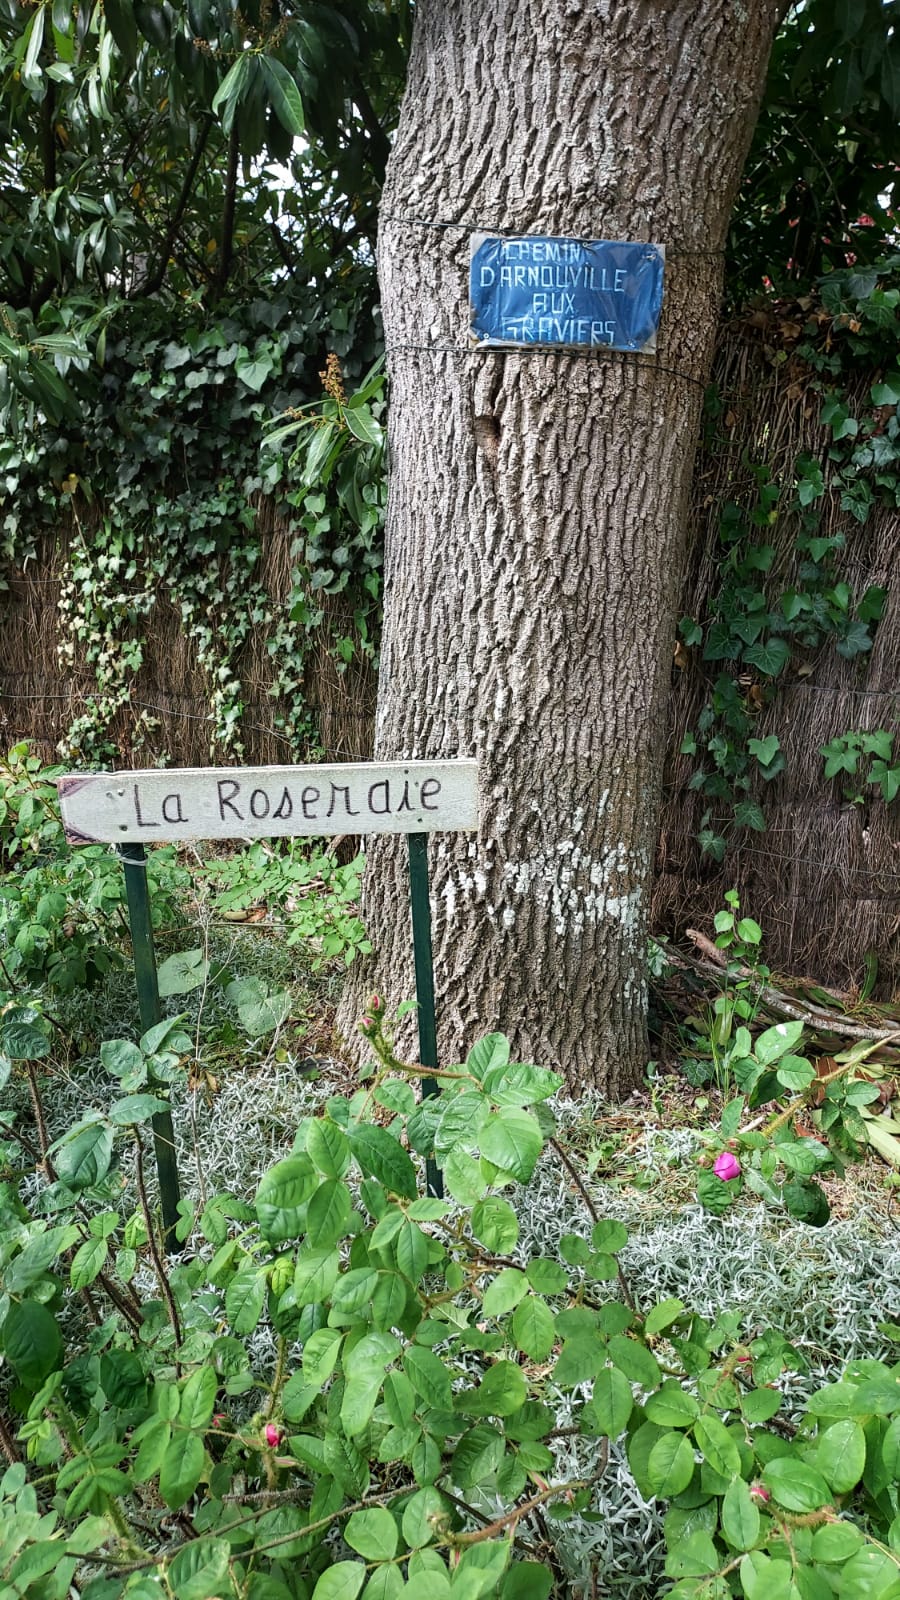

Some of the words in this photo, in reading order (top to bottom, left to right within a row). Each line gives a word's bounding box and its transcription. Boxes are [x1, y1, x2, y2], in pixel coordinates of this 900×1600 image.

[505, 240, 581, 262] CHEMIN
[533, 292, 576, 315] AUX
[502, 315, 616, 347] GRAVIERS
[134, 783, 189, 828] La
[217, 770, 442, 822] Roseraie
